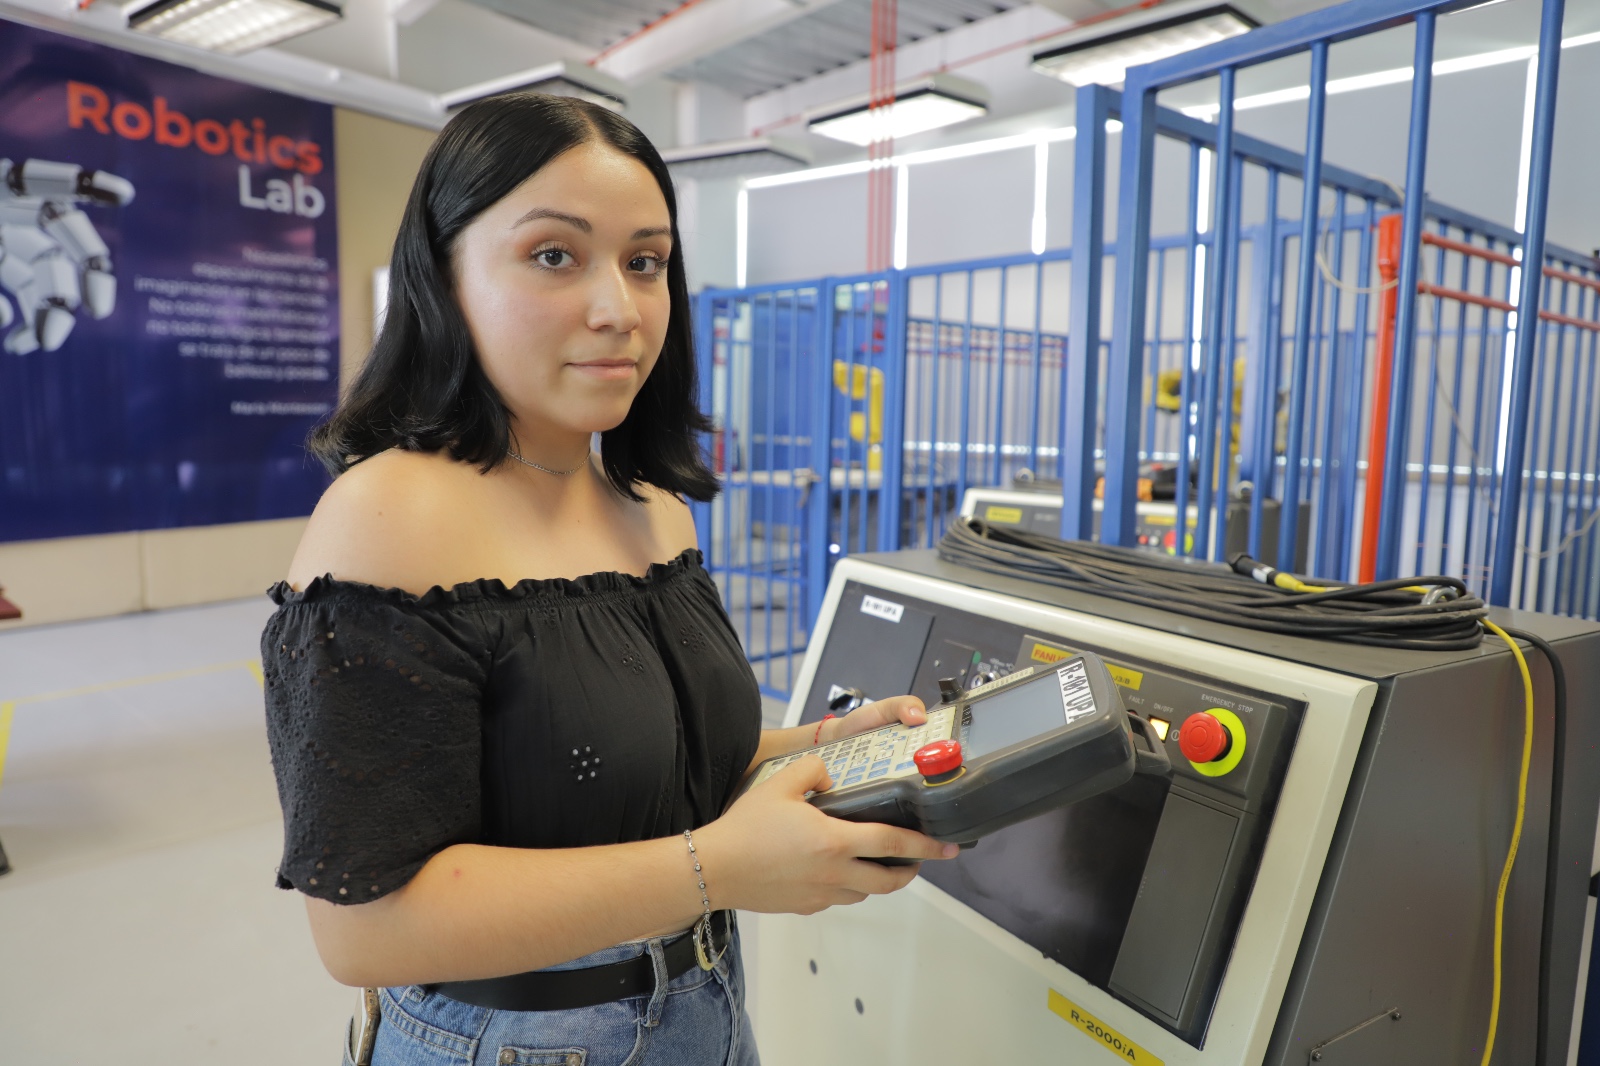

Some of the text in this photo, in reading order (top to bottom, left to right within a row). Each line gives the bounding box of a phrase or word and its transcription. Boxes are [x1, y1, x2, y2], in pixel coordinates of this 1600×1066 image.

[66, 79, 323, 175] Robotics
[238, 164, 325, 218] Lab
[1128, 694, 1174, 714] FAULT ON/OFF
[1201, 694, 1254, 714] EMERGENCY STOP
[1070, 1009, 1136, 1061] R-2000iA
